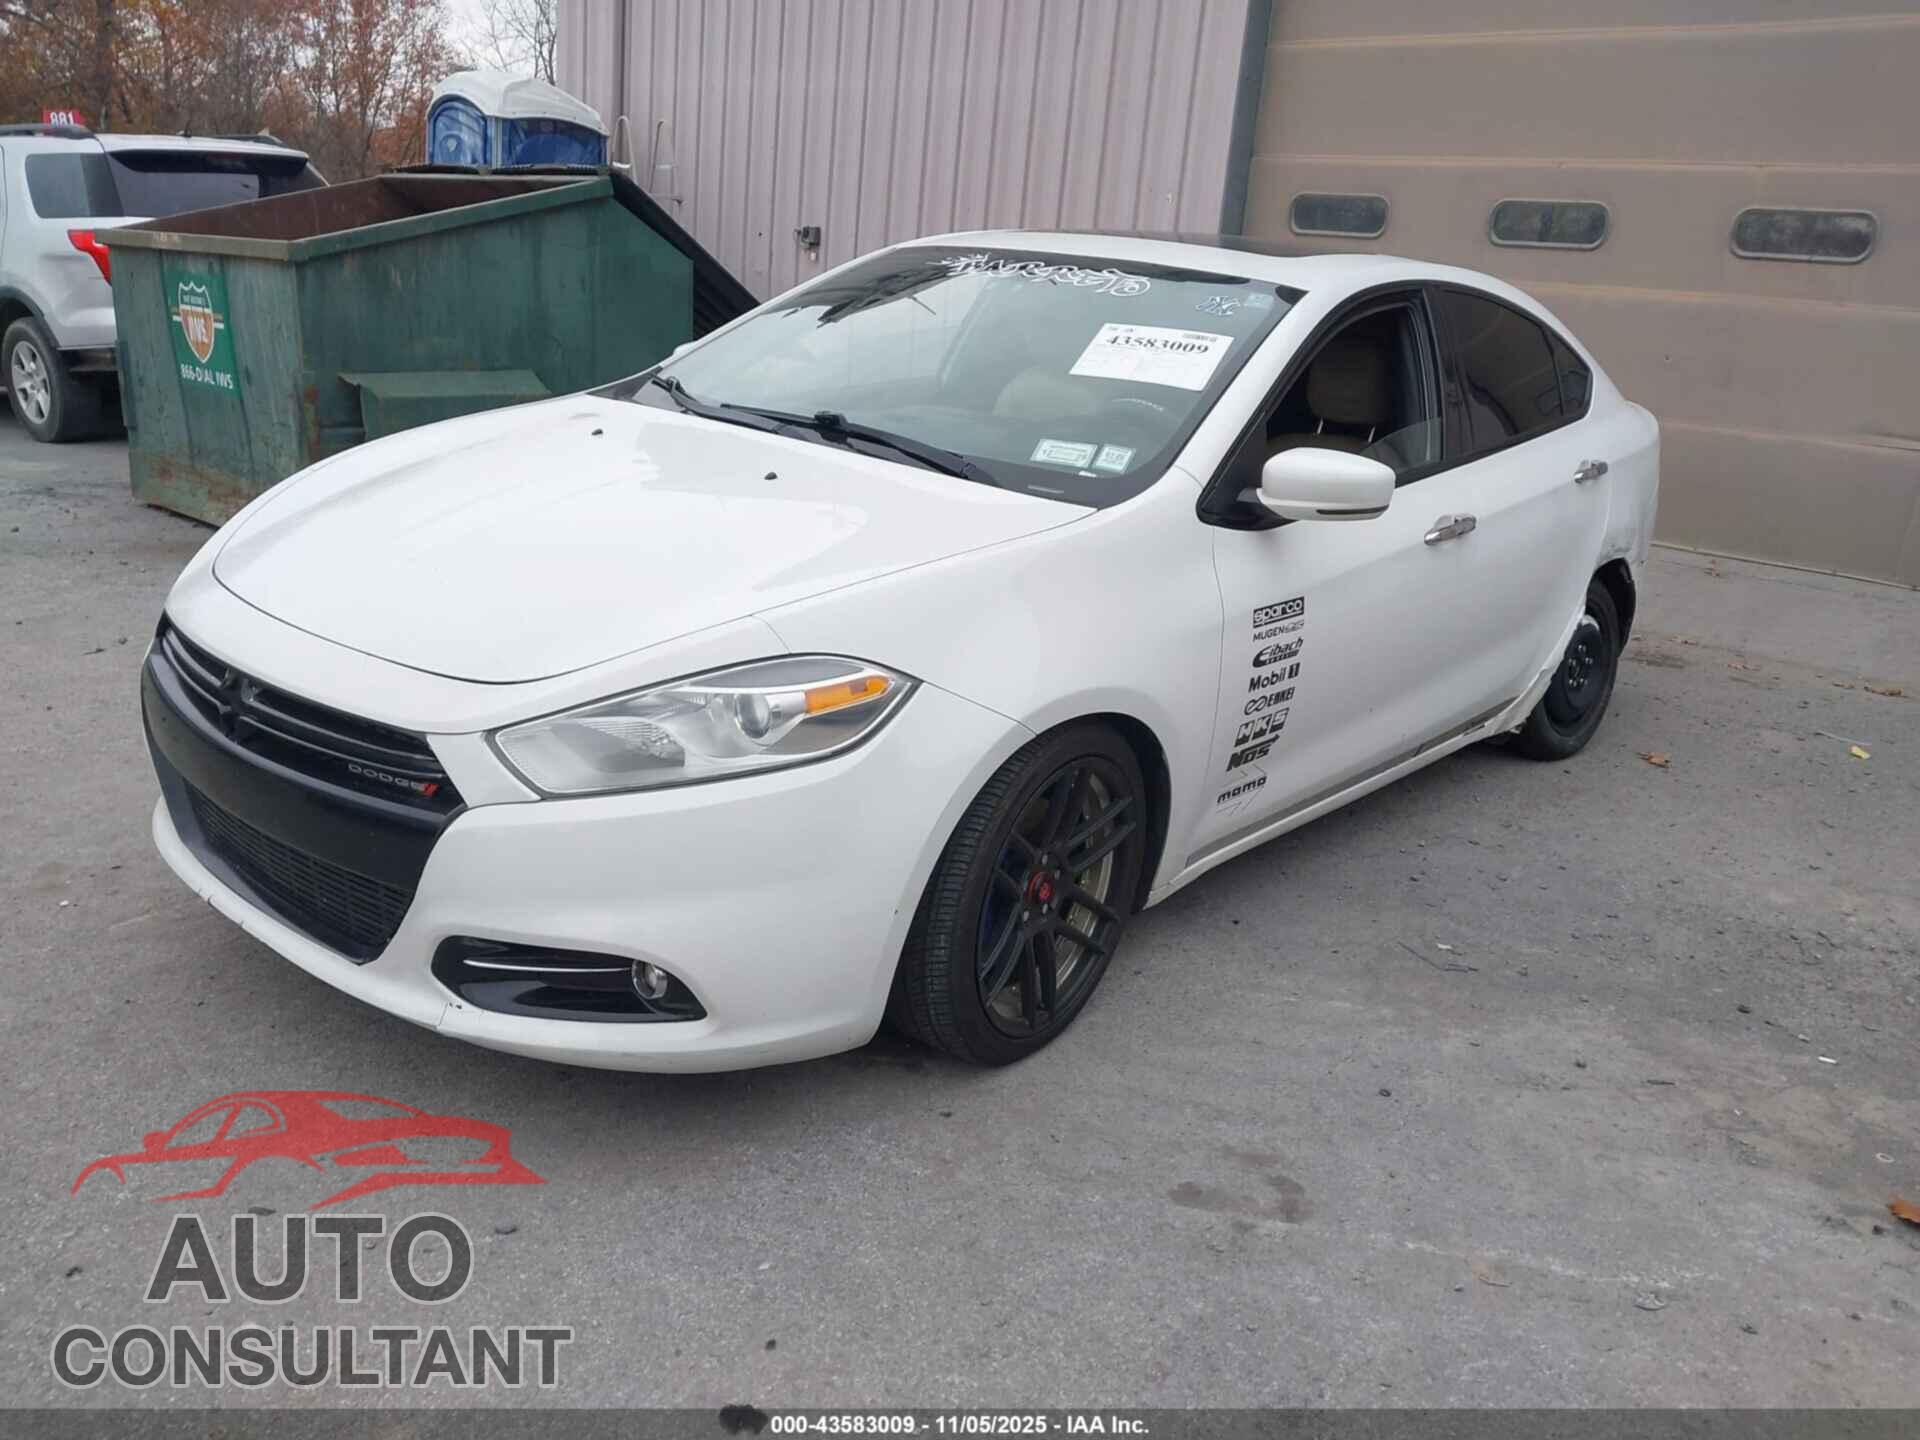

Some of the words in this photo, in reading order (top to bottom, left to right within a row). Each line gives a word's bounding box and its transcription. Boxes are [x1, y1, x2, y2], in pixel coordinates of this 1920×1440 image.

[1105, 334, 1209, 354] 43583009
[1253, 598, 1304, 627] sparco
[1253, 626, 1285, 642] MUGEN
[1252, 637, 1303, 668] Eibach
[1248, 667, 1287, 693] Mobil
[347, 763, 425, 792] DODGE
